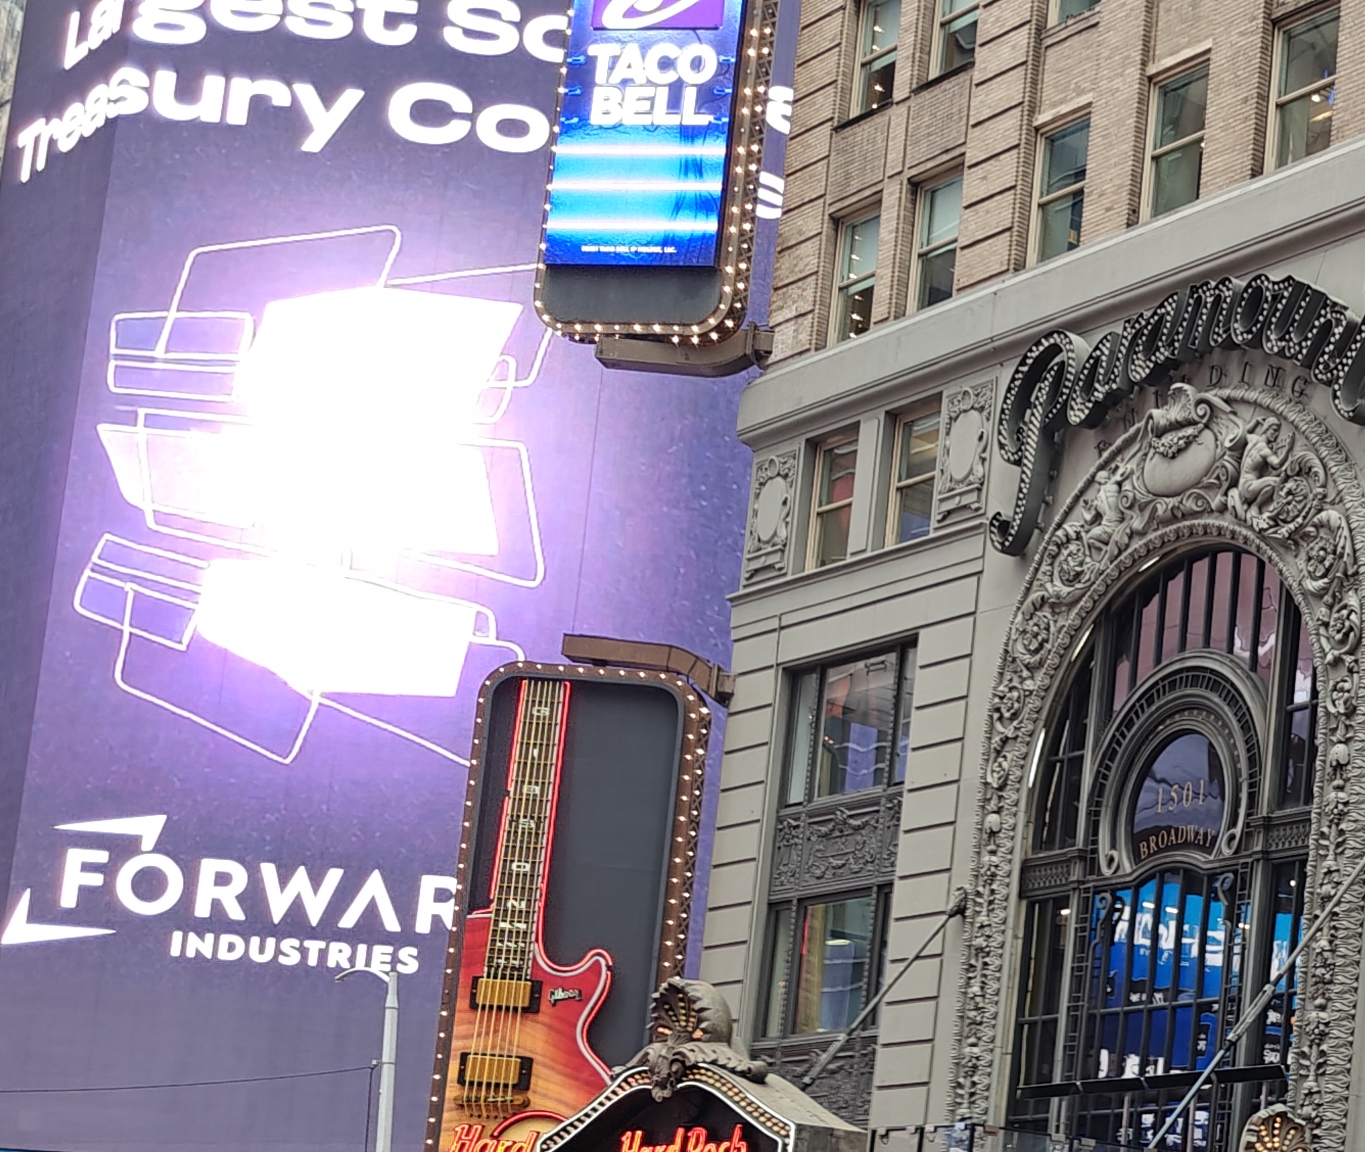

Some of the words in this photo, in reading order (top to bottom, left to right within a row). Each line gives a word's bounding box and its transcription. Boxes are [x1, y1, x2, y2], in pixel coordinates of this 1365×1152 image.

[587, 43, 718, 85] TACO
[17, 66, 365, 182] Treasury
[590, 86, 714, 126] BELL
[1156, 778, 1206, 814] 1501
[1139, 825, 1215, 860] BROADWAY
[170, 930, 419, 974] INDUSTRIES
